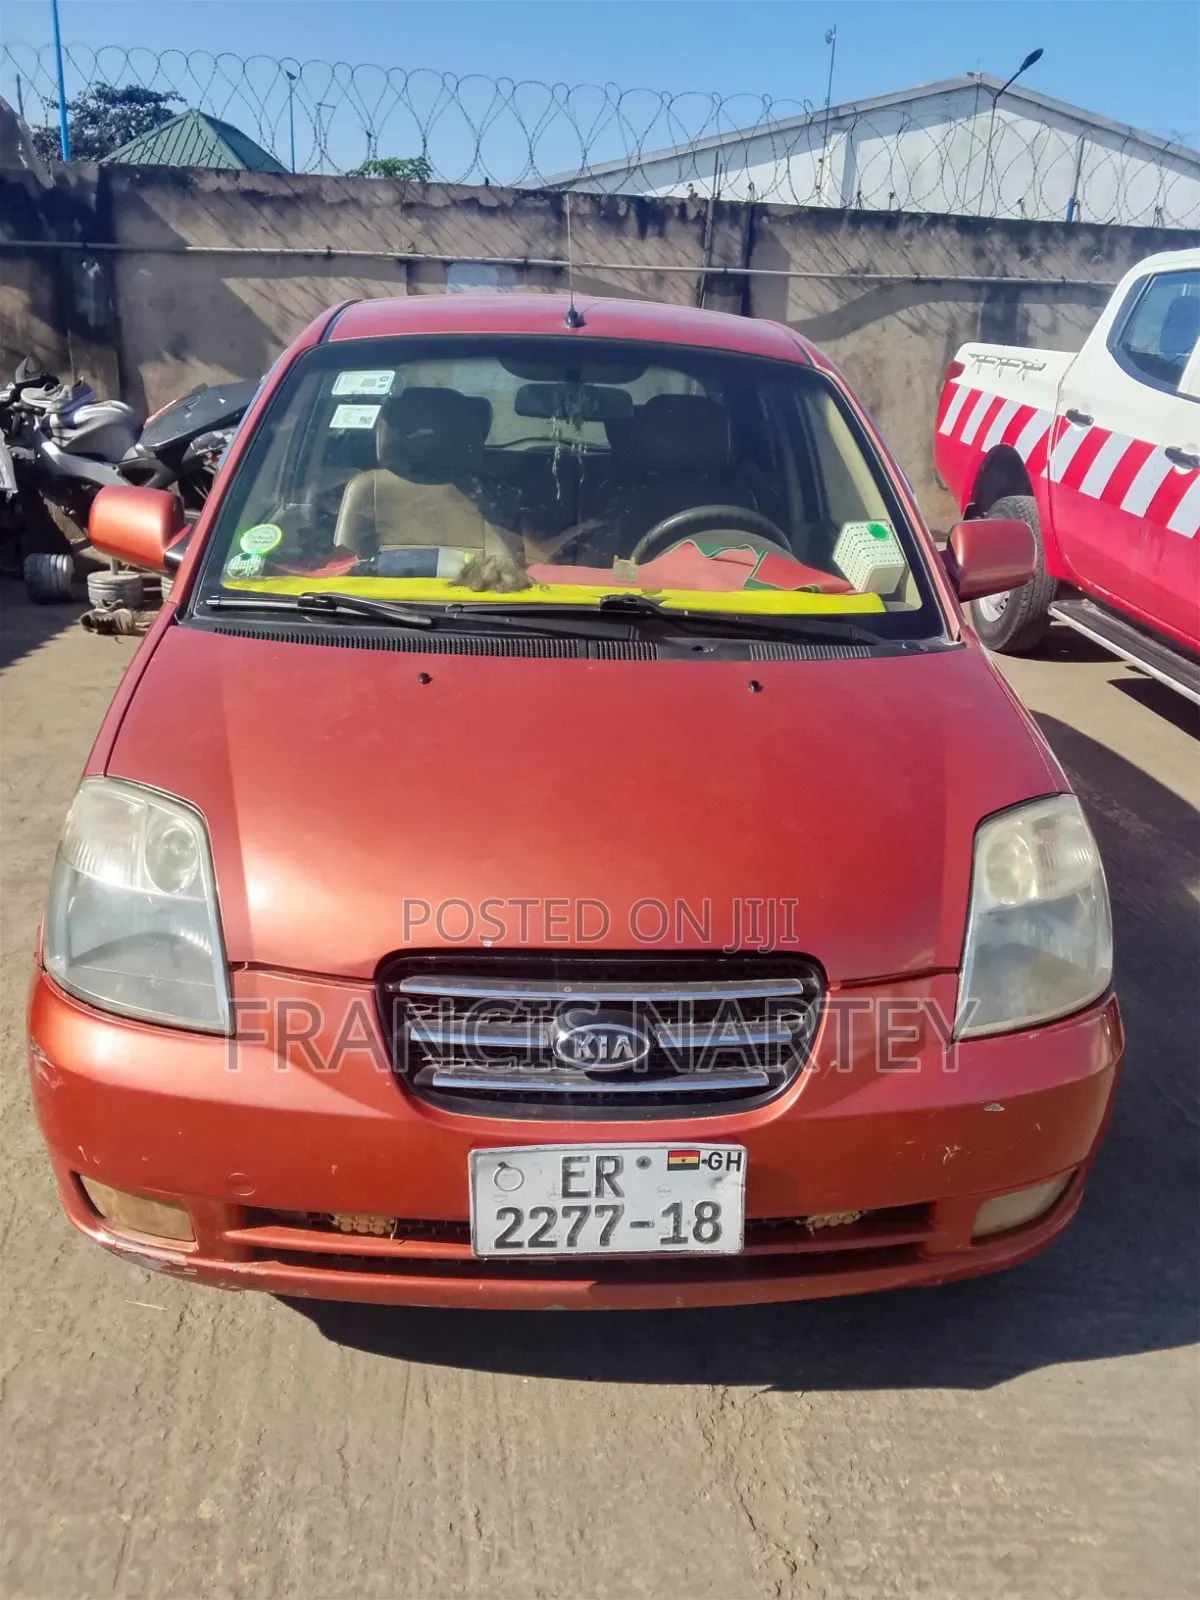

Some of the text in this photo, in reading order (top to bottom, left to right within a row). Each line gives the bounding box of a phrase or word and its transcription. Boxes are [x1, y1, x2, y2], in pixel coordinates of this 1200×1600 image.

[574, 1035, 634, 1059] KIA
[561, 1151, 741, 1198] ER GH
[494, 1200, 724, 1250] 2277-18
